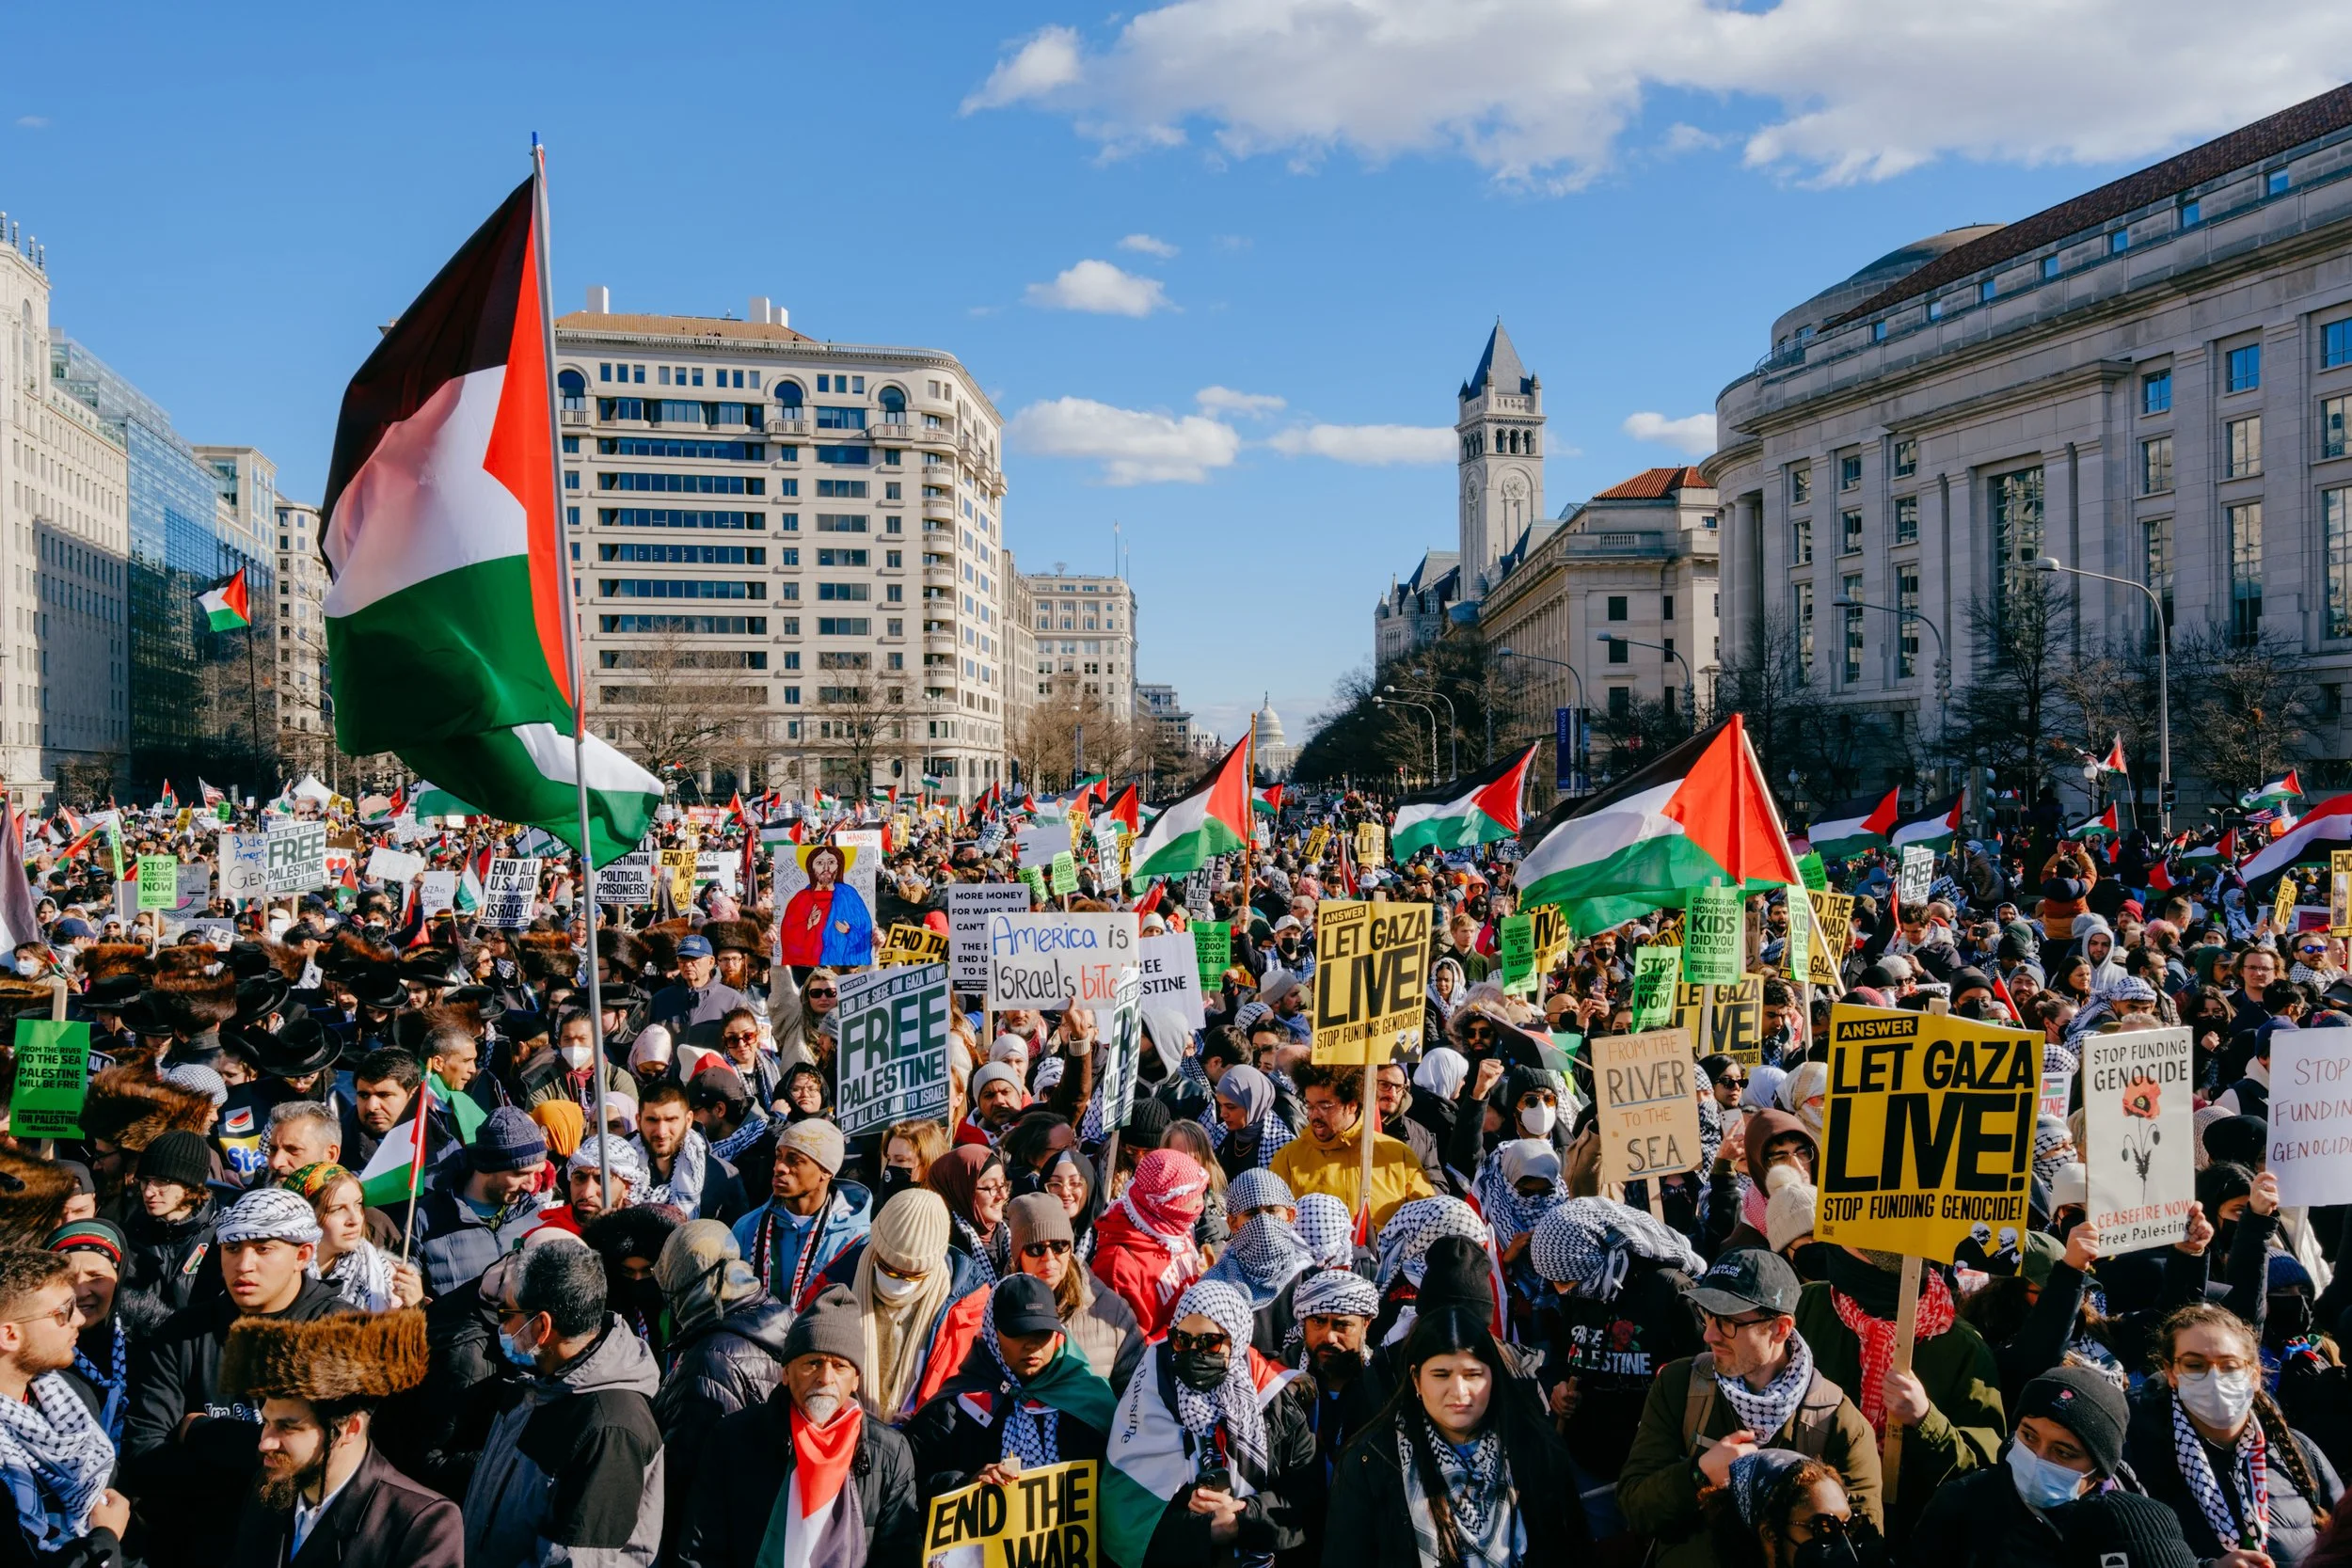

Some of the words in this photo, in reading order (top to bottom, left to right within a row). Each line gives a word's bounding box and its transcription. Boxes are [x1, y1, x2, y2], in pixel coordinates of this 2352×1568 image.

[232, 835, 266, 849] Bide
[847, 832, 873, 843] HANDS
[980, 829, 1005, 842] FREE
[268, 831, 325, 868] FREE
[661, 851, 683, 866] END
[684, 850, 696, 865] THE
[142, 862, 172, 871] STOP
[267, 858, 323, 882] PALESTINE!
[492, 860, 517, 876] END
[518, 861, 537, 877] ALL
[1022, 869, 1040, 880] STOP
[1054, 863, 1073, 875] KIDS
[1902, 859, 1932, 889] FREE
[489, 876, 512, 892] U.S.
[516, 877, 534, 892] AID
[600, 870, 644, 882] POLITICAL
[142, 881, 172, 892] NOW
[596, 883, 648, 895] PRISONERS!
[487, 894, 497, 903] TO
[955, 892, 983, 900] MORE
[1692, 896, 1726, 905] GENOCIDE
[485, 903, 529, 919] ISRAEL!
[1692, 905, 1714, 914] HOW
[1715, 907, 1738, 915] MANY
[1808, 894, 1824, 914] ND
[1828, 895, 1851, 918] THE
[1324, 907, 1364, 925] ANSWER
[1691, 914, 1736, 934] KIDS
[956, 923, 985, 931] CAN'T
[993, 915, 1098, 956] America
[1107, 924, 1129, 949] is
[1321, 922, 1364, 962] LET
[1370, 909, 1427, 951] GAZA
[1534, 911, 1568, 950] IVE!
[1819, 915, 1847, 939] WAR
[890, 927, 923, 951] END
[926, 934, 949, 962] TH
[961, 942, 981, 951] THE
[1691, 934, 1711, 945] DID
[1714, 935, 1735, 946] YOU
[957, 955, 978, 963] END
[1708, 946, 1734, 955] TODAY?
[1138, 958, 1163, 974] REE
[1203, 956, 1226, 964] GAZA
[1507, 958, 1533, 967] TAXPAYER
[1640, 957, 1675, 974] STOP
[1690, 964, 1703, 973] FOR
[1704, 965, 1734, 974] PALESTINE
[962, 967, 977, 975] TO
[1639, 973, 1673, 984] FUNDING
[840, 976, 867, 992] ANSWER
[841, 997, 856, 1017] END
[857, 990, 869, 1008] THE
[871, 982, 890, 1003] SIEGE
[892, 977, 903, 995] ON
[905, 972, 925, 990] GAZA
[926, 963, 946, 983] NOW!
[1081, 963, 1120, 1001] bitc
[1139, 975, 1187, 995] ESTINE
[1317, 941, 1426, 1030] LIVE!
[1638, 983, 1672, 992] APARTHEID
[1636, 991, 1670, 1010] NOW
[1714, 979, 1760, 1004] GAZA
[840, 984, 946, 1082] FREE
[1317, 1028, 1340, 1050] STOP
[1343, 1020, 1379, 1044] FUNDING
[1382, 1008, 1422, 1034] GENOCIDE!
[1840, 1020, 1914, 1039] ANSWER
[20, 1045, 42, 1053] FROM
[1608, 1039, 1646, 1062] FROM
[1649, 1035, 1679, 1054] THE
[2093, 1046, 2127, 1065] STOP
[2131, 1039, 2187, 1059] FUNDING
[19, 1053, 35, 1064] TO
[37, 1054, 58, 1065] THE
[60, 1055, 81, 1066] SEA
[88, 1054, 102, 1071] AX
[1833, 1042, 1914, 1095] LET
[1923, 1039, 2035, 1090] GAZA
[19, 1068, 80, 1079] PALESTINE
[2094, 1059, 2188, 1092] GENOCIDE
[2295, 1057, 2351, 1085] STOP
[19, 1079, 40, 1088] WILL
[42, 1080, 56, 1088] BE
[56, 1080, 80, 1089] FREE
[840, 1048, 946, 1114] PALESTINE!
[1607, 1059, 1689, 1104] RIVER
[840, 1114, 856, 1133] END
[856, 1108, 870, 1128] ALL
[871, 1101, 887, 1120] U.S.
[888, 1095, 904, 1115] AID
[906, 1092, 918, 1109] TO
[920, 1085, 948, 1107] ISRAEL
[1620, 1112, 1642, 1128] TO
[1645, 1106, 1672, 1122] THE
[2275, 1100, 2352, 1127] FUNDIN
[18, 1114, 33, 1123] FOR
[1824, 1092, 2033, 1194] LIVE!
[2272, 1136, 2352, 1163] GENOCID
[227, 1147, 266, 1173] Sta
[1627, 1133, 1684, 1172] SEA
[1823, 1197, 1863, 1221] STOP
[1869, 1194, 1934, 1220] FUNDING
[1941, 1195, 2023, 1221] GENOCIDE!
[2097, 1204, 2160, 1229] CEASEFIRE
[2164, 1199, 2193, 1215] NOW
[2098, 1228, 2127, 1247] Free
[1720, 1269, 1739, 1277] LAND
[1729, 1265, 1741, 1274] ON
[1120, 1368, 1147, 1445] Palestine
[930, 1483, 1008, 1550] END
[1018, 1467, 1089, 1533] THE
[1002, 1524, 1089, 1568] WAR
